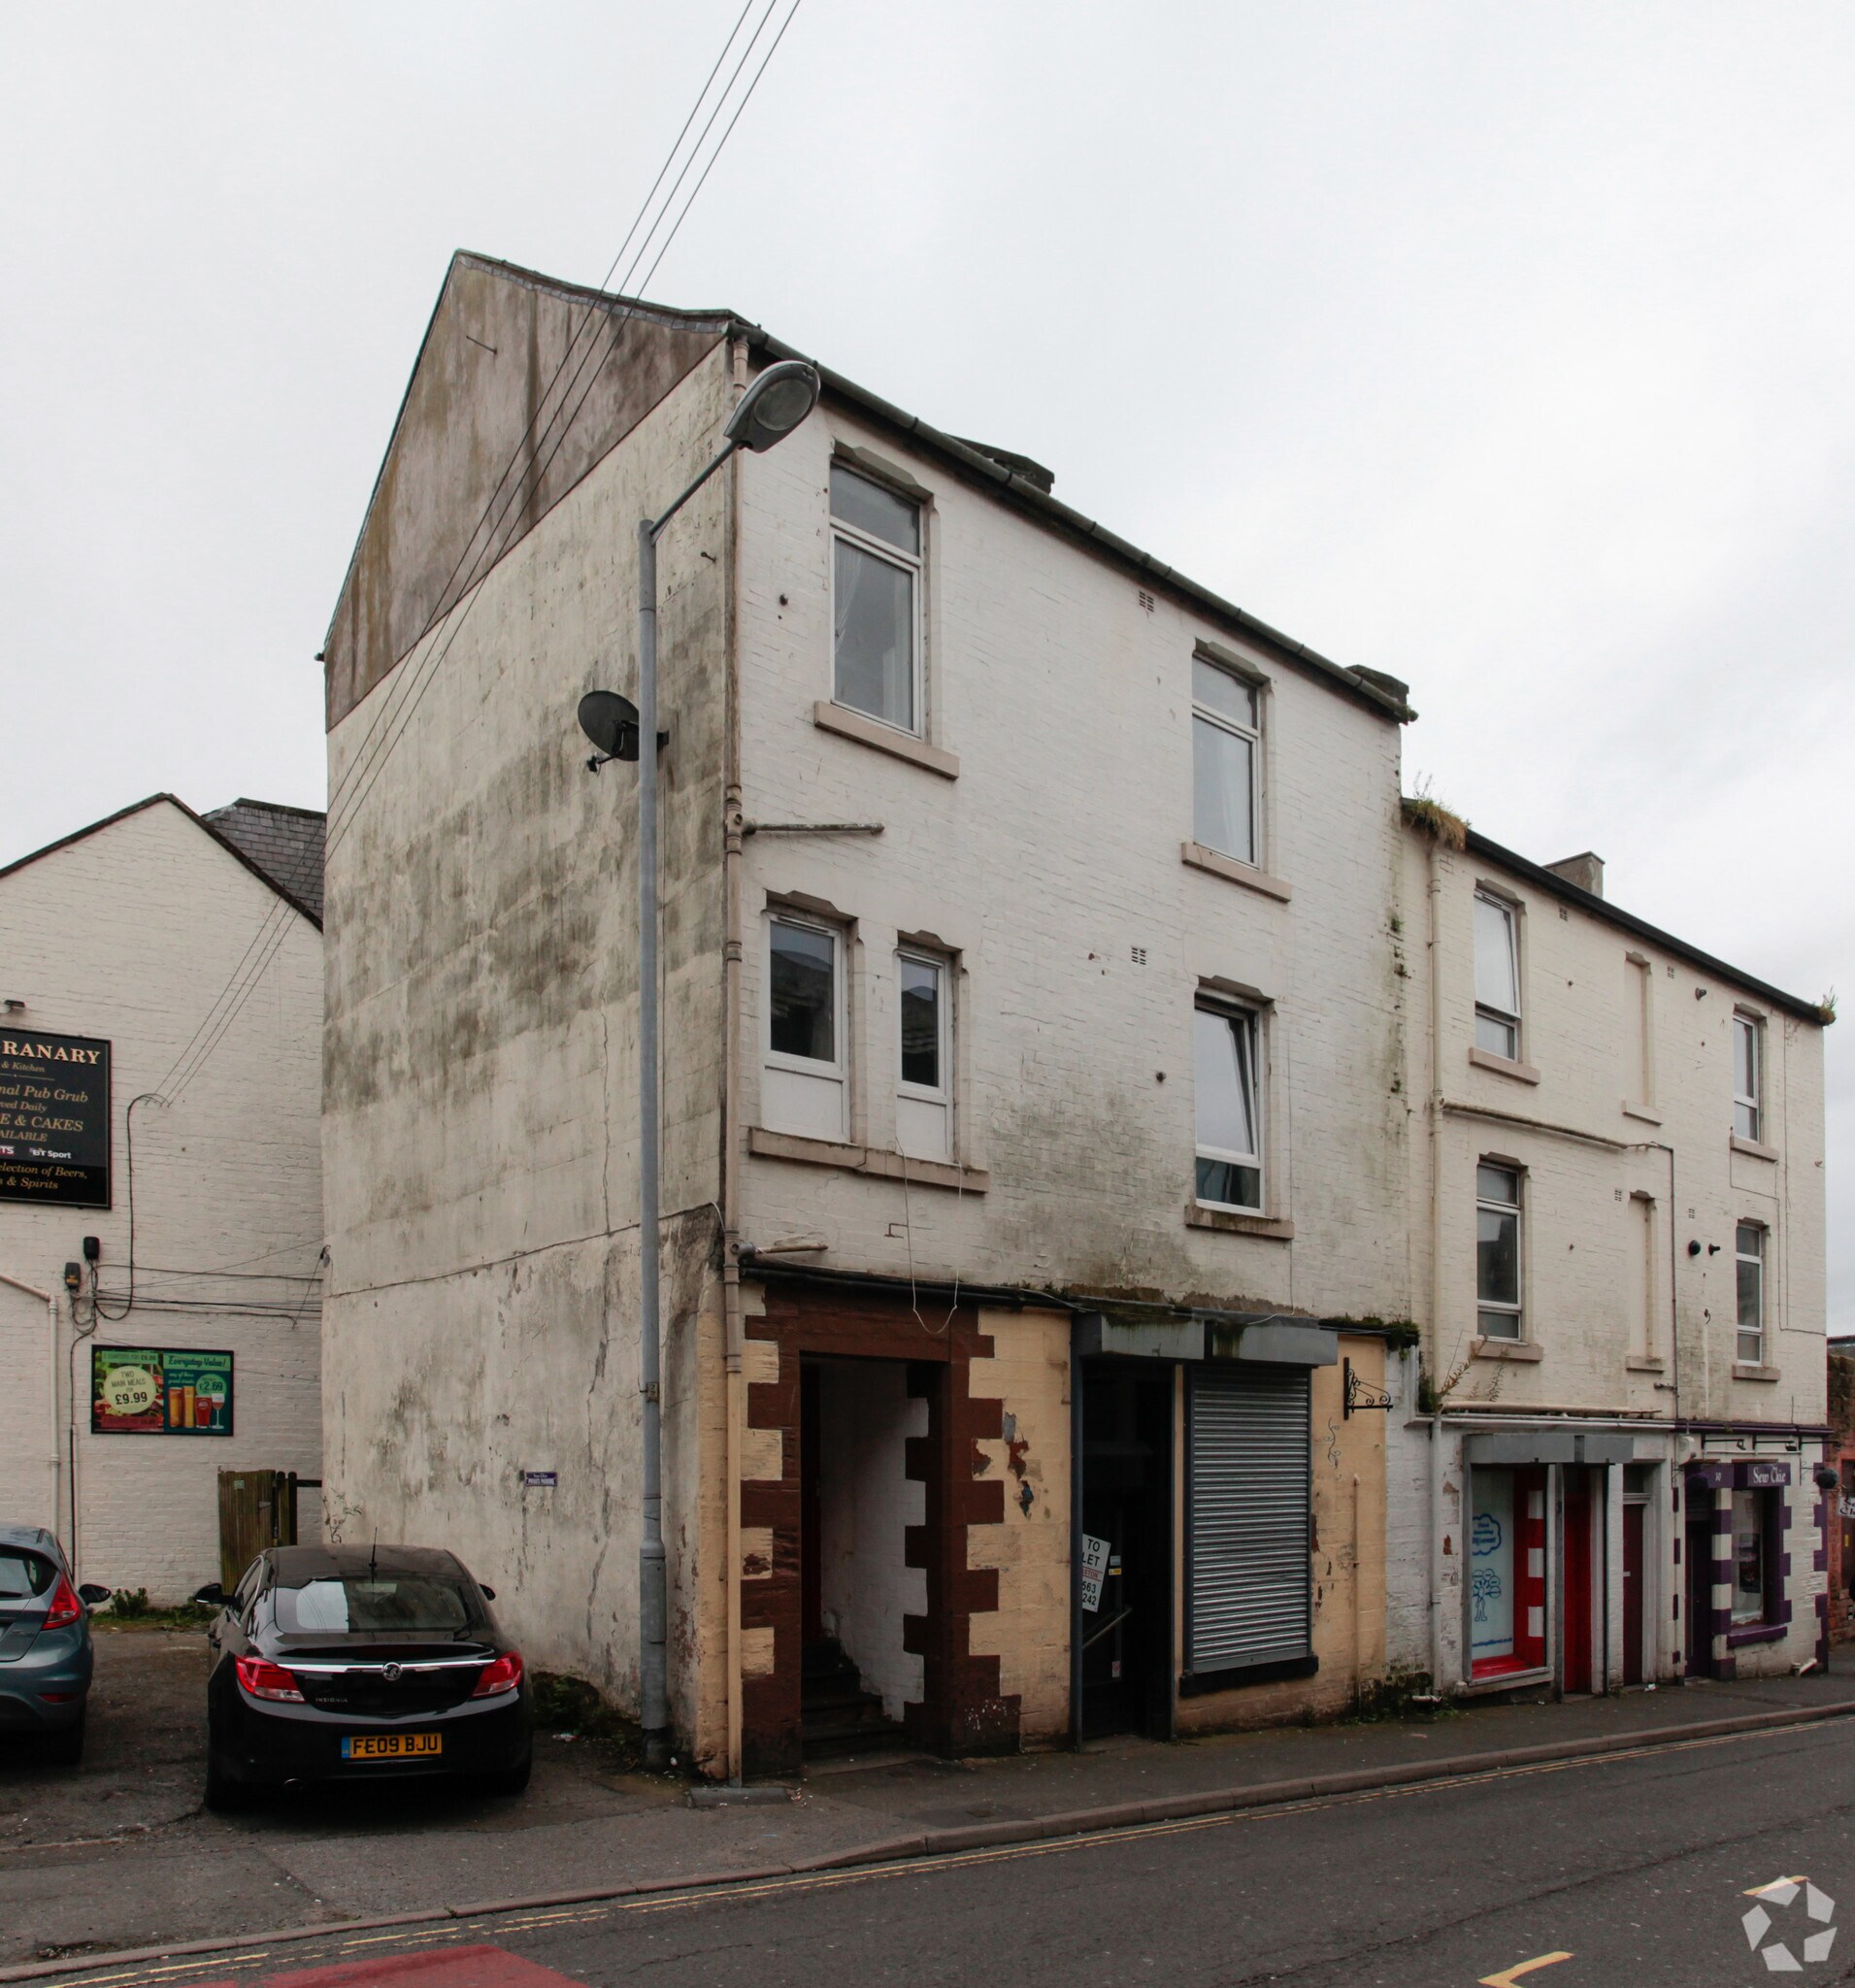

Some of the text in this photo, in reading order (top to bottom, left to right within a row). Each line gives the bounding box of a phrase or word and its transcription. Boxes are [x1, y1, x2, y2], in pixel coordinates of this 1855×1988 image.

[0, 1040, 101, 1065] RANARY
[13, 1061, 46, 1073] Kitchen
[23, 1085, 50, 1099] Pub
[53, 1088, 88, 1103] Grub
[20, 1101, 48, 1113] Daily
[15, 1114, 27, 1126] &
[31, 1115, 84, 1132] CAKES
[47, 1150, 72, 1159] Sport
[41, 1166, 53, 1177] of
[55, 1167, 88, 1179] Beers,
[20, 1177, 59, 1190] Spirits
[127, 1377, 147, 1386] MEALS
[199, 1381, 223, 1391] £2.69
[115, 1391, 148, 1406] £9.99
[1087, 1539, 1101, 1552] TO
[1082, 1552, 1101, 1568] LET
[1082, 1593, 1097, 1606] 242
[352, 1736, 439, 1755] FE09 BJU
